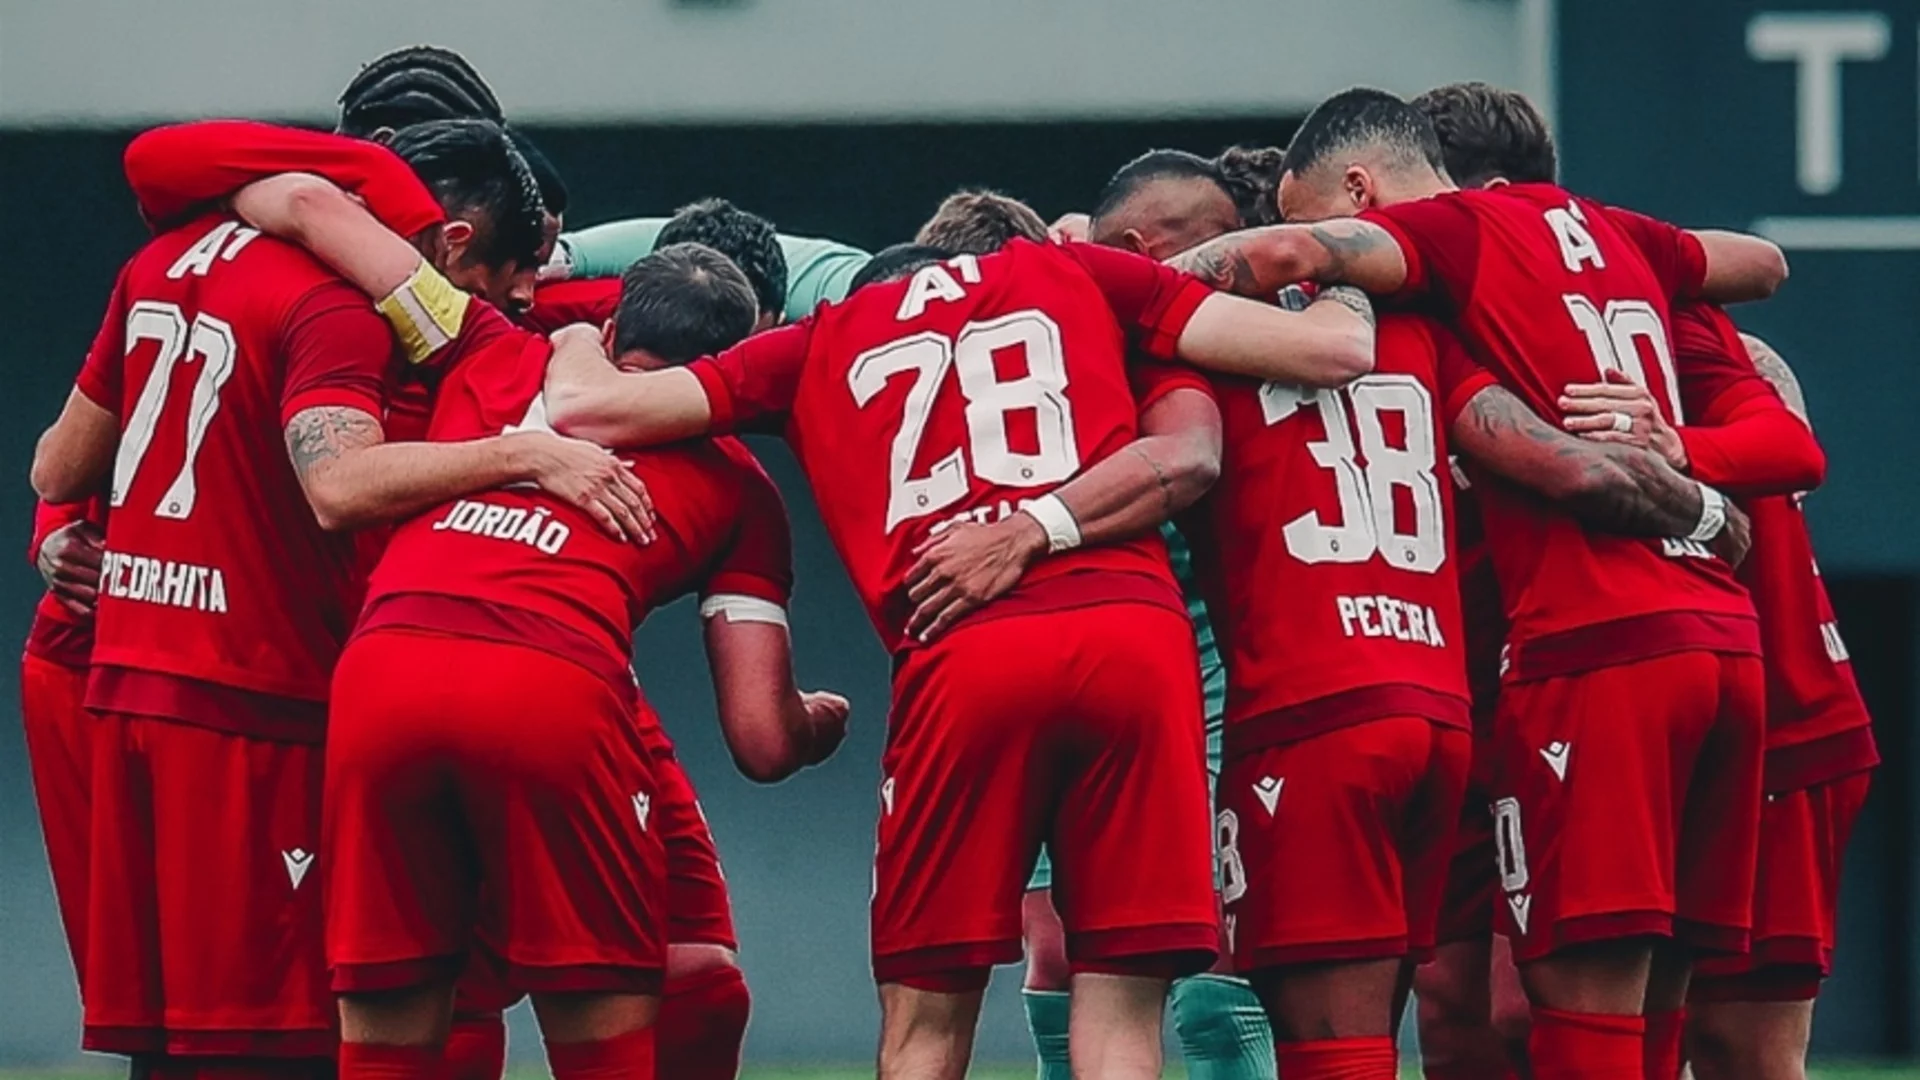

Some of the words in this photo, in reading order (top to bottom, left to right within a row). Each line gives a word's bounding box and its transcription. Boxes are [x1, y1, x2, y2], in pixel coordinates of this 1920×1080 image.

[166, 221, 262, 279] A1
[895, 253, 982, 321] A1
[110, 301, 237, 519] 77
[848, 309, 1081, 536] 28
[1258, 374, 1447, 574] 38
[433, 500, 570, 555] JORDÃO
[99, 550, 228, 613] PIEDRHITA
